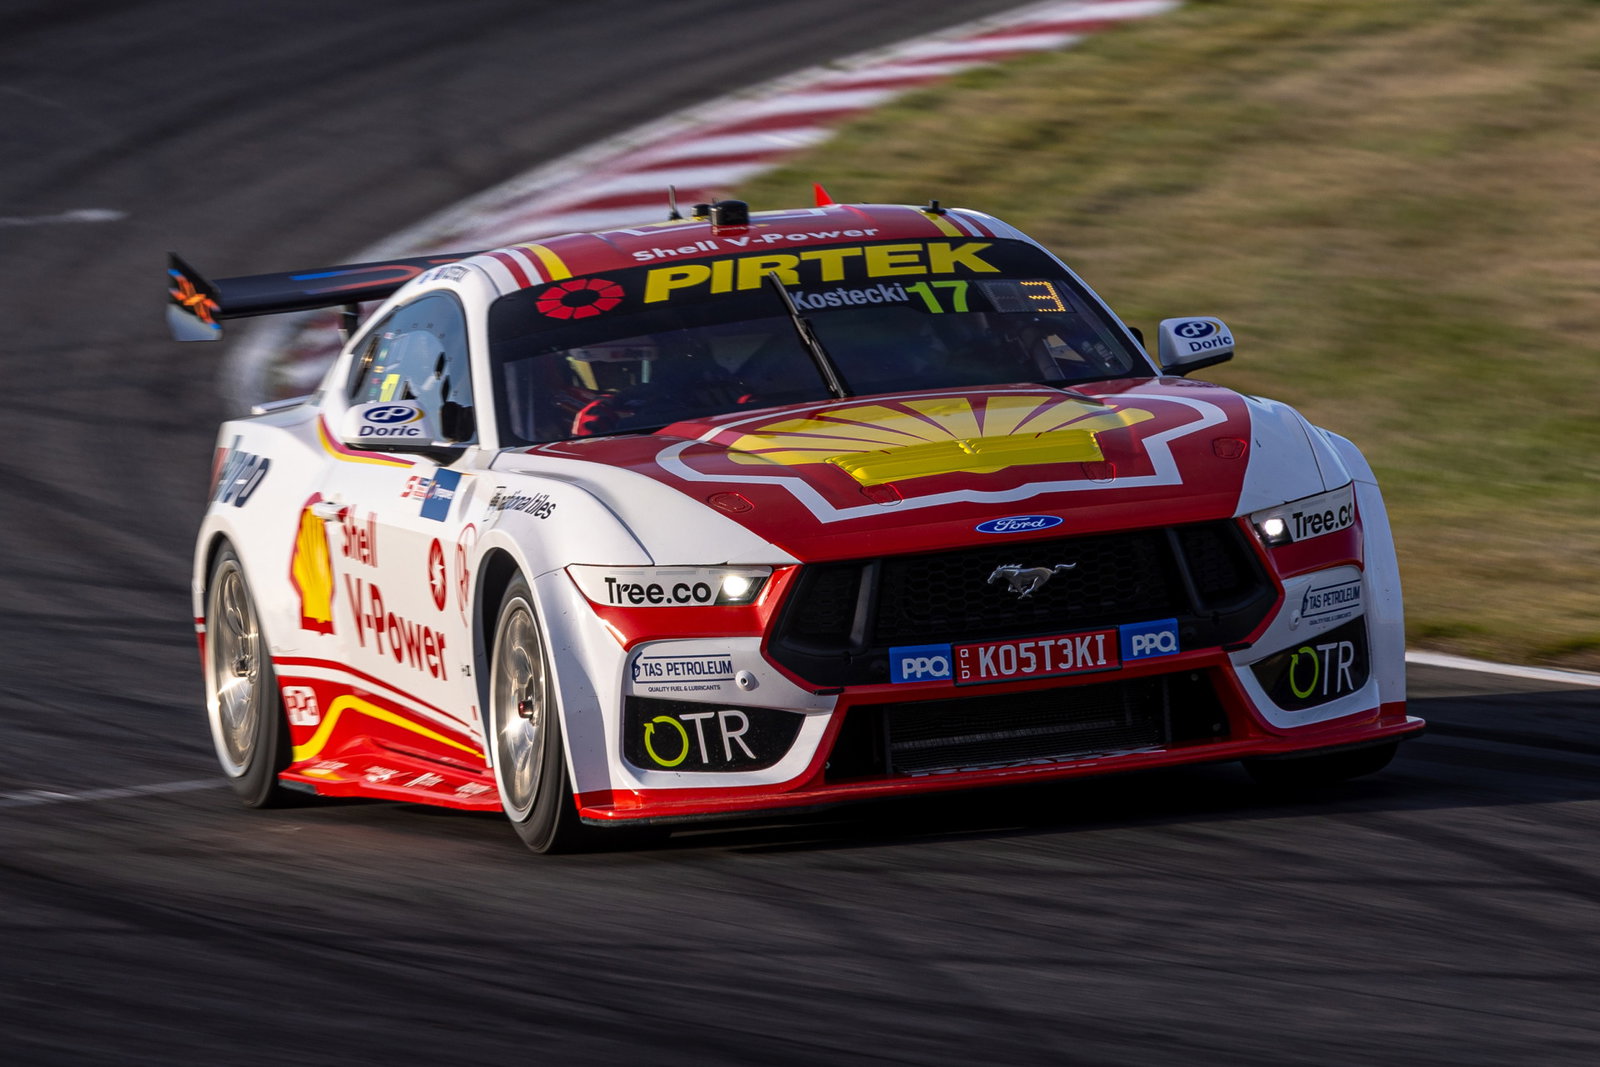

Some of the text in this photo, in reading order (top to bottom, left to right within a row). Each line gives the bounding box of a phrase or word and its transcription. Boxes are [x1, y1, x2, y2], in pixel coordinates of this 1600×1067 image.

[632, 227, 880, 262] Shell V-Power
[643, 241, 1002, 304] PIRTEK
[789, 280, 970, 314] Kostecki 17
[1020, 281, 1066, 313] 3
[1189, 335, 1232, 352] Doric
[358, 425, 421, 437] Doric
[341, 504, 378, 568] Shell
[993, 517, 1047, 532] Ford
[604, 577, 712, 604] Tree.co
[1309, 585, 1361, 610] TAS PETROLEUM
[343, 573, 448, 681] V-Power
[1132, 630, 1177, 657] PPQ
[642, 660, 734, 677] TAS PETROLEUM
[902, 655, 950, 680] PPQ
[959, 648, 971, 680] QLD
[1289, 640, 1355, 698] OTR
[644, 709, 757, 767] OTR
